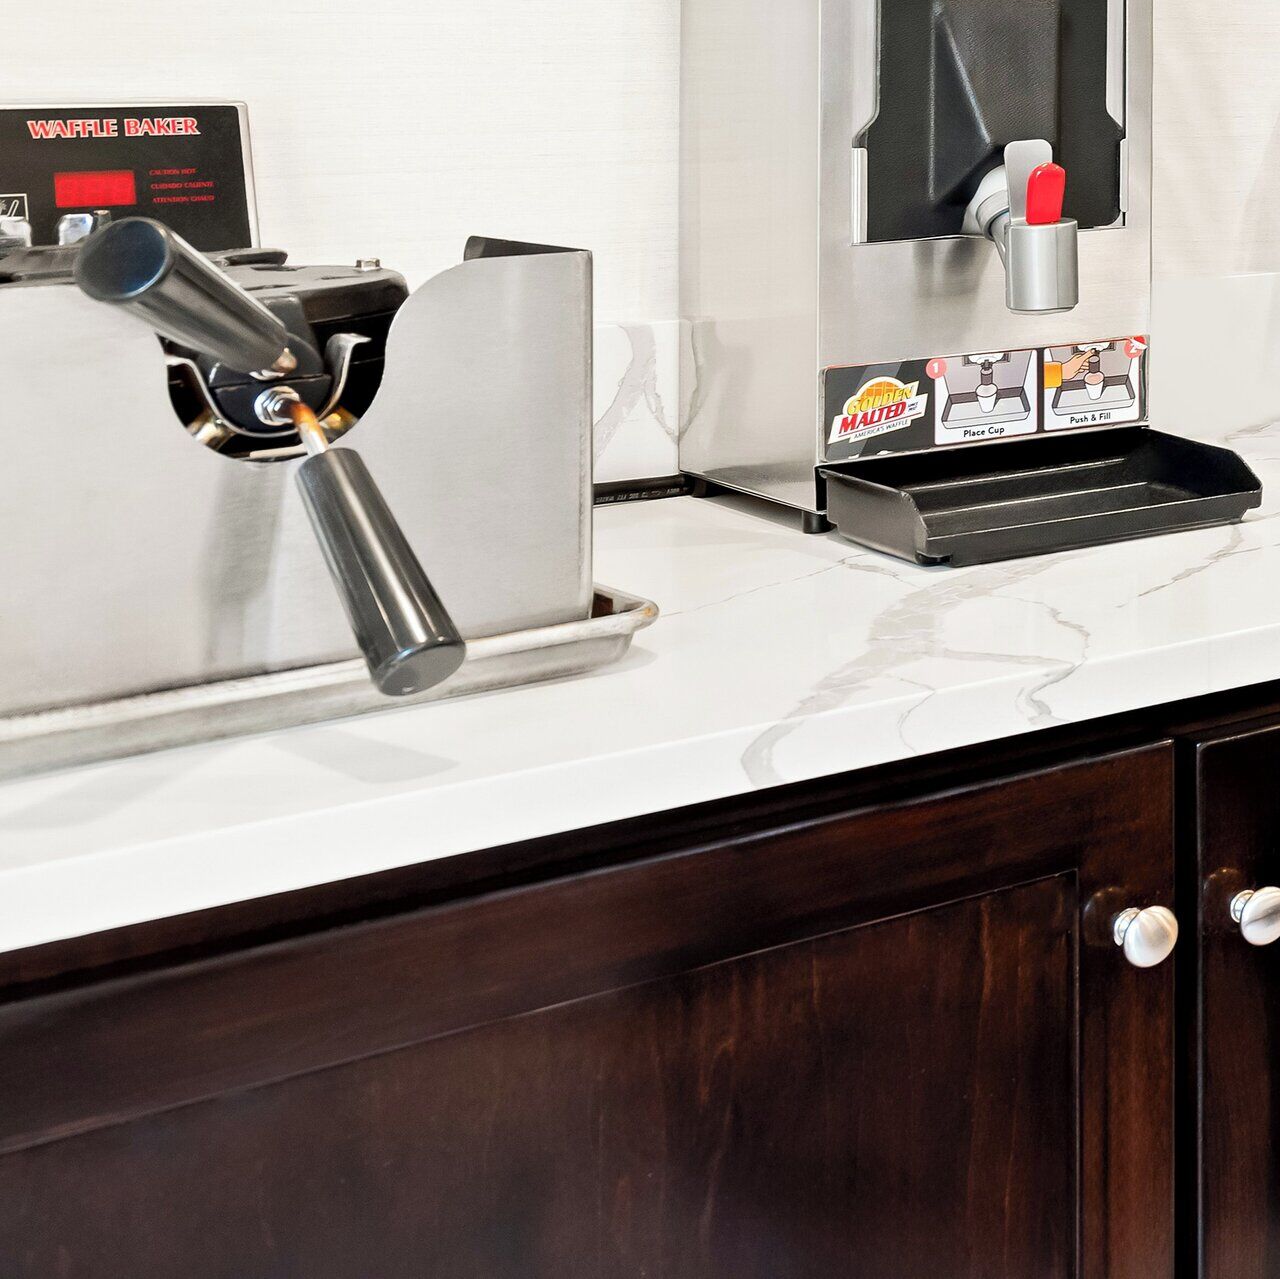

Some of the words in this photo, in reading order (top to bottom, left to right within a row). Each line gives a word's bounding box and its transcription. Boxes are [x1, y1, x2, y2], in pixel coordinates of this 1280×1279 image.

[26, 118, 118, 139] WAFFLE
[124, 117, 201, 137] BAKER
[932, 362, 939, 373] 1
[847, 387, 913, 415] GOLDEN
[839, 401, 907, 434] MALTED
[1070, 413, 1088, 424] Push
[1091, 413, 1097, 422] &
[1099, 412, 1111, 421] Fill
[854, 425, 885, 439] AMERICA'S
[886, 419, 909, 431] WAFFLE
[963, 427, 986, 438] Place
[988, 426, 1005, 438] Cup
